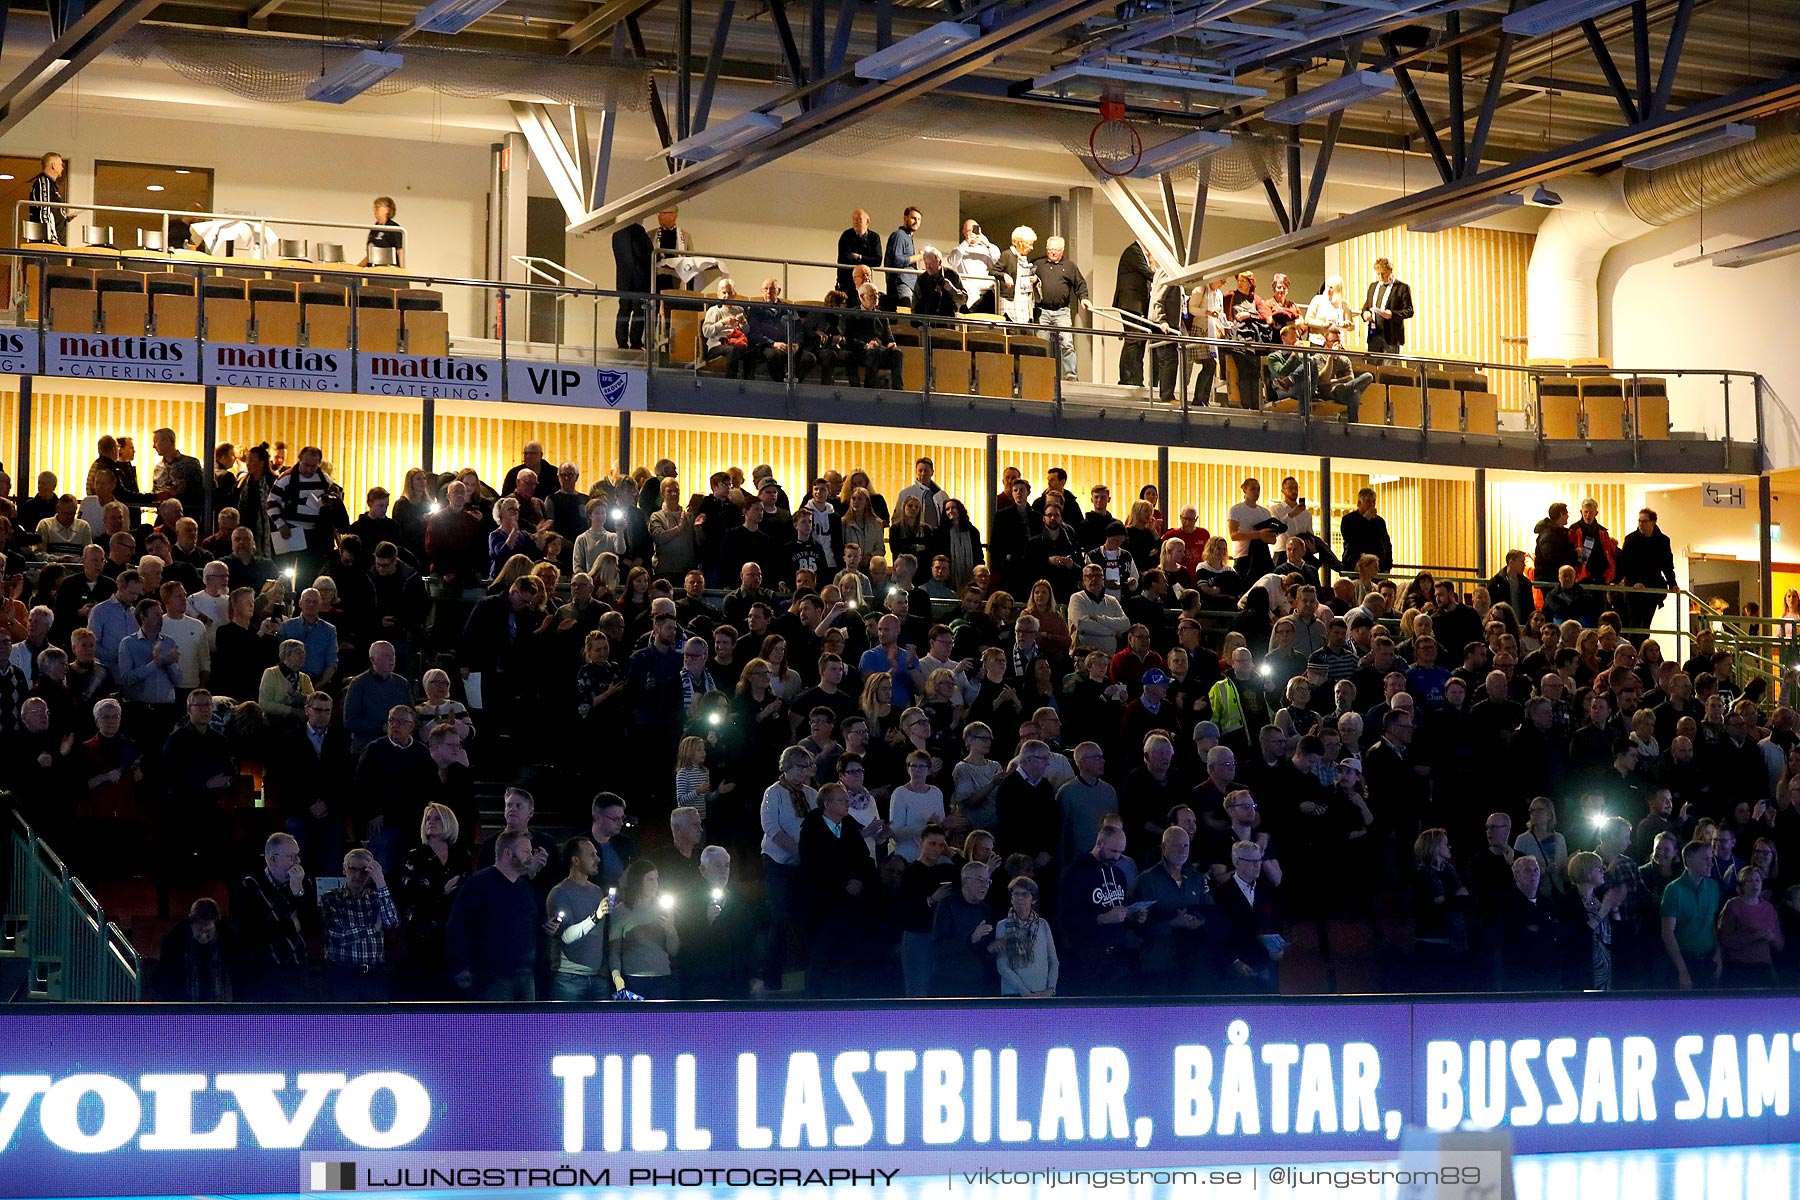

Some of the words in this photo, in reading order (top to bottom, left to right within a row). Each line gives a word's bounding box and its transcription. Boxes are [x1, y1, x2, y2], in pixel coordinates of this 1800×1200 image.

[60, 337, 183, 361] mattias
[218, 347, 338, 373] mattias
[71, 364, 173, 380] CATERING
[372, 357, 488, 382] mattias
[228, 374, 328, 391] CATERING
[382, 383, 478, 400] CATERING
[526, 367, 581, 397] VIP
[552, 1053, 712, 1154] TILL
[737, 1047, 1153, 1149] LASTBILAR,
[1174, 1020, 1402, 1140] BÅTAR,
[1426, 1036, 1657, 1132] BUSSAR
